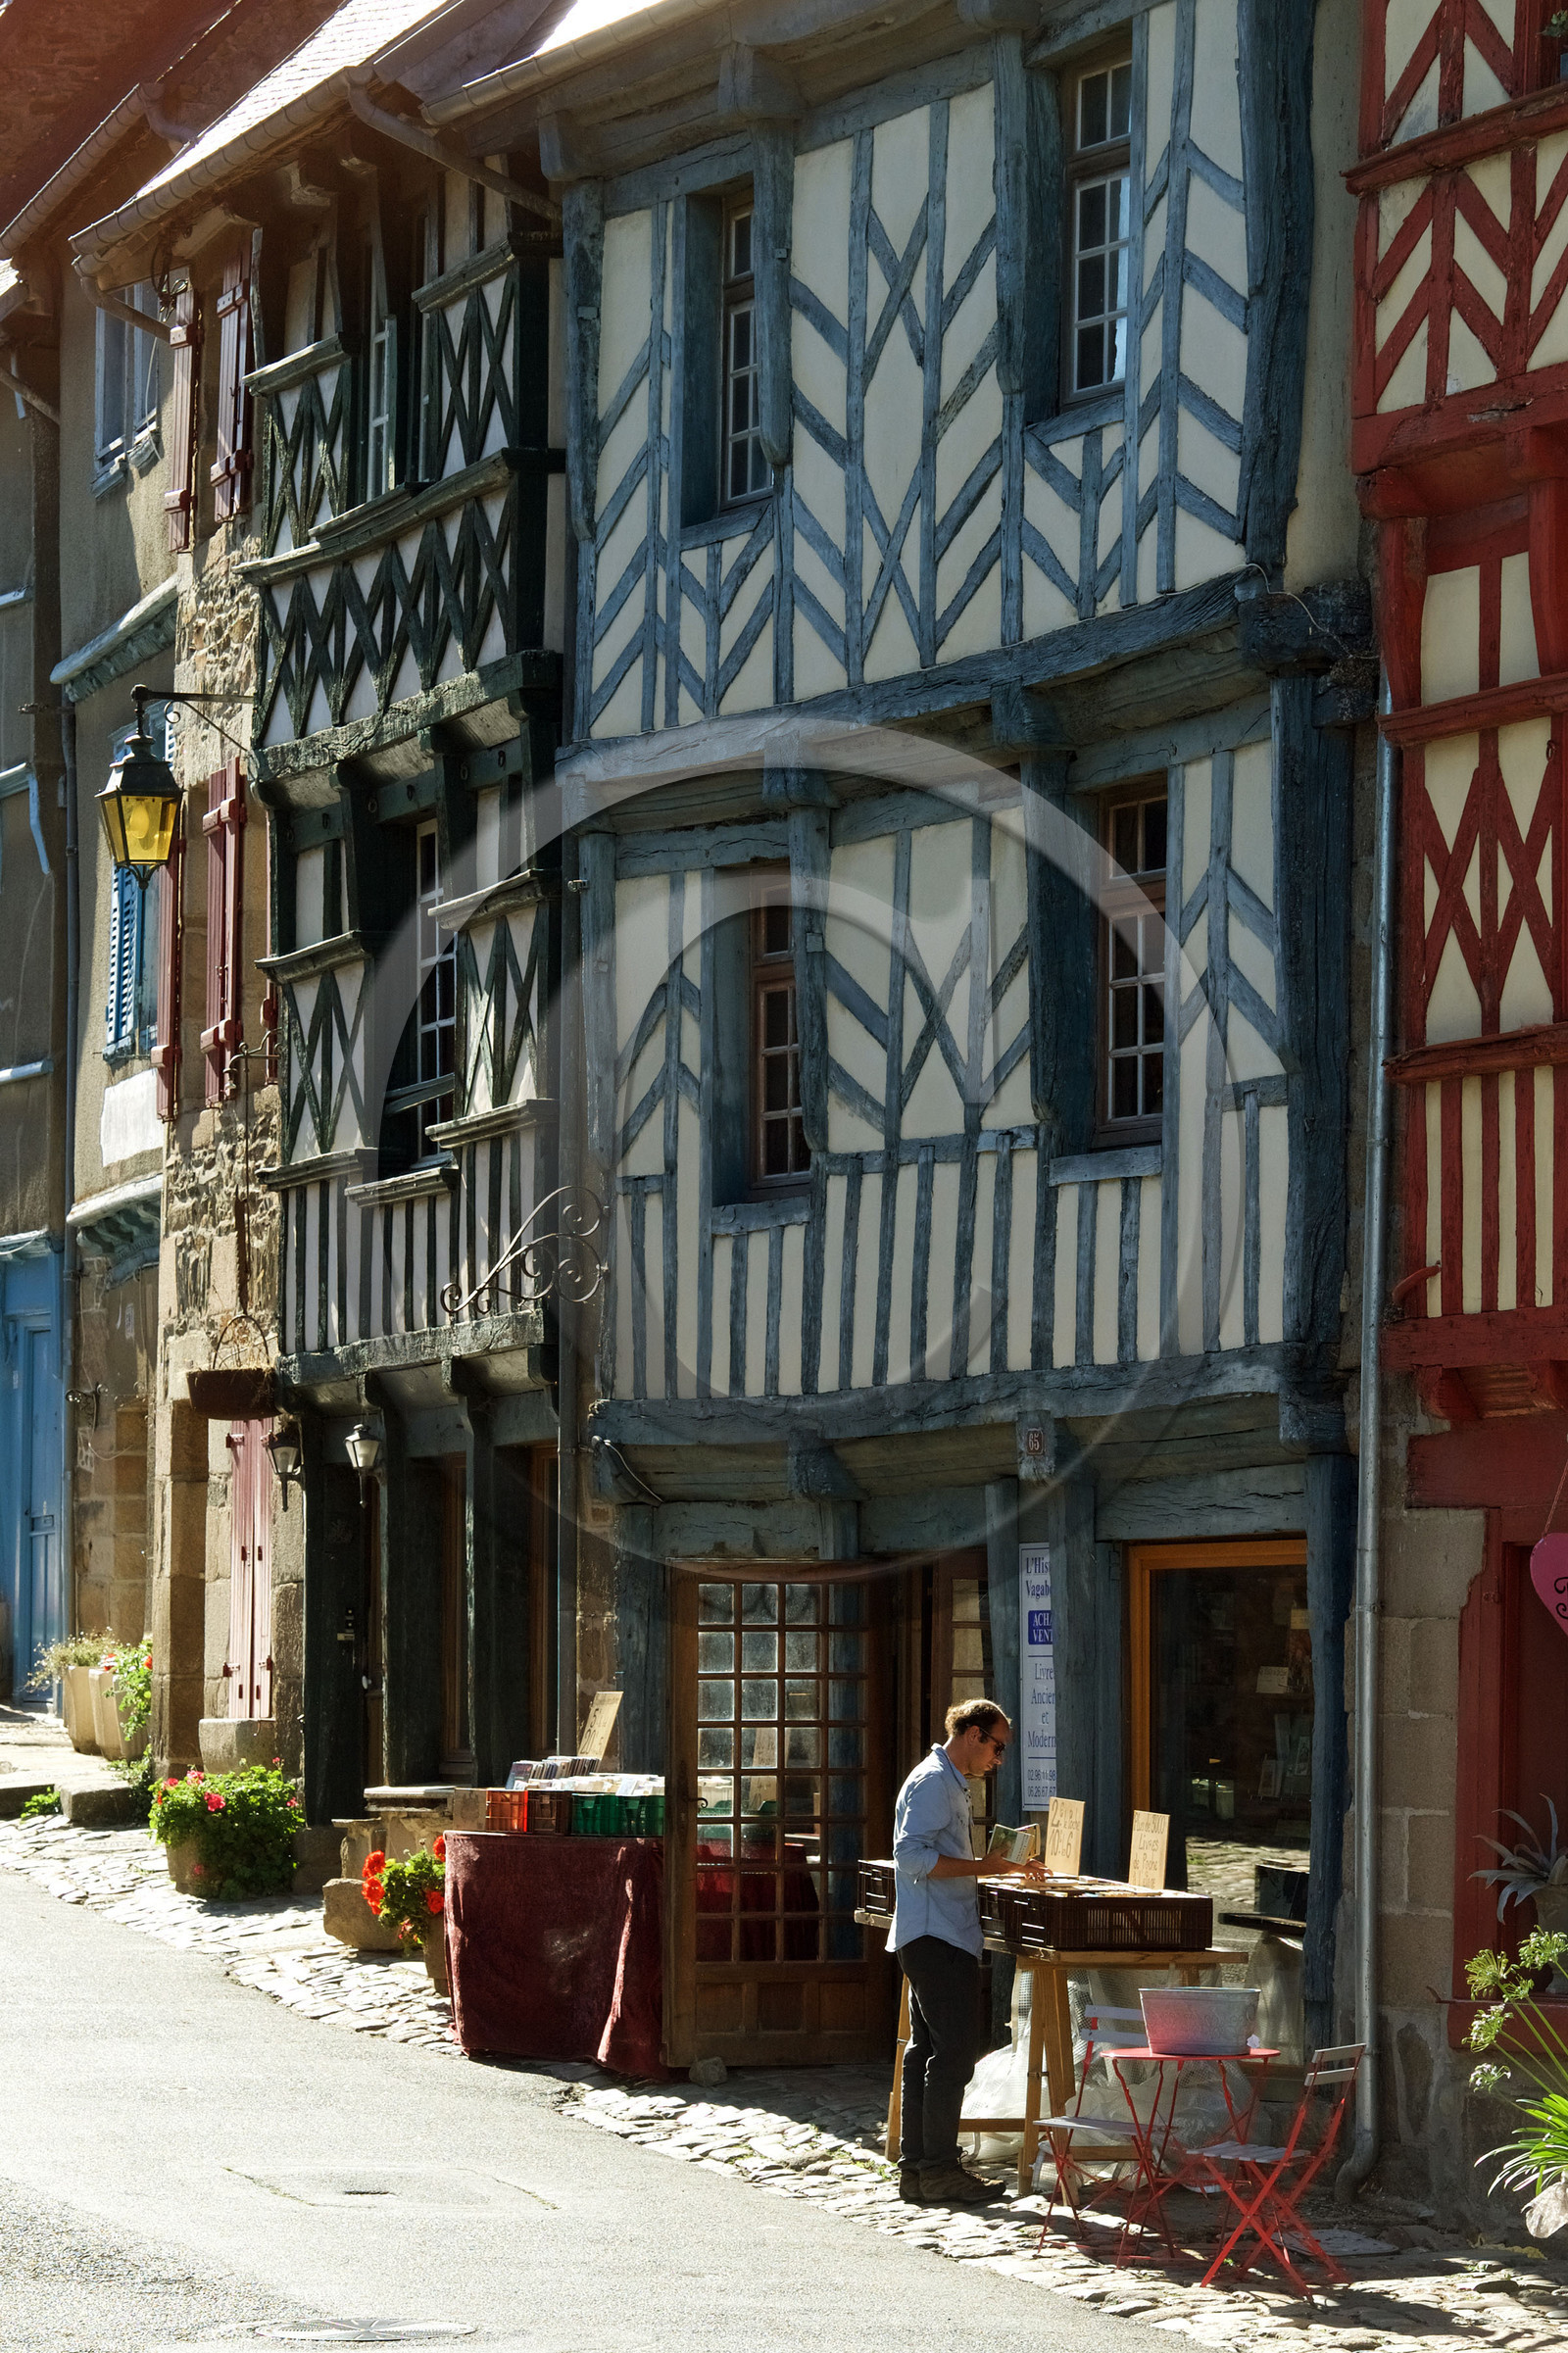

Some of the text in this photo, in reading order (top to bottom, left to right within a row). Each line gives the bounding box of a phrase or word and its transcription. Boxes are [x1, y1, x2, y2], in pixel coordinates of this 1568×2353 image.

[1028, 1433, 1040, 1450] 65
[1026, 1580, 1052, 1599] Vagab
[1042, 1712, 1050, 1724] et
